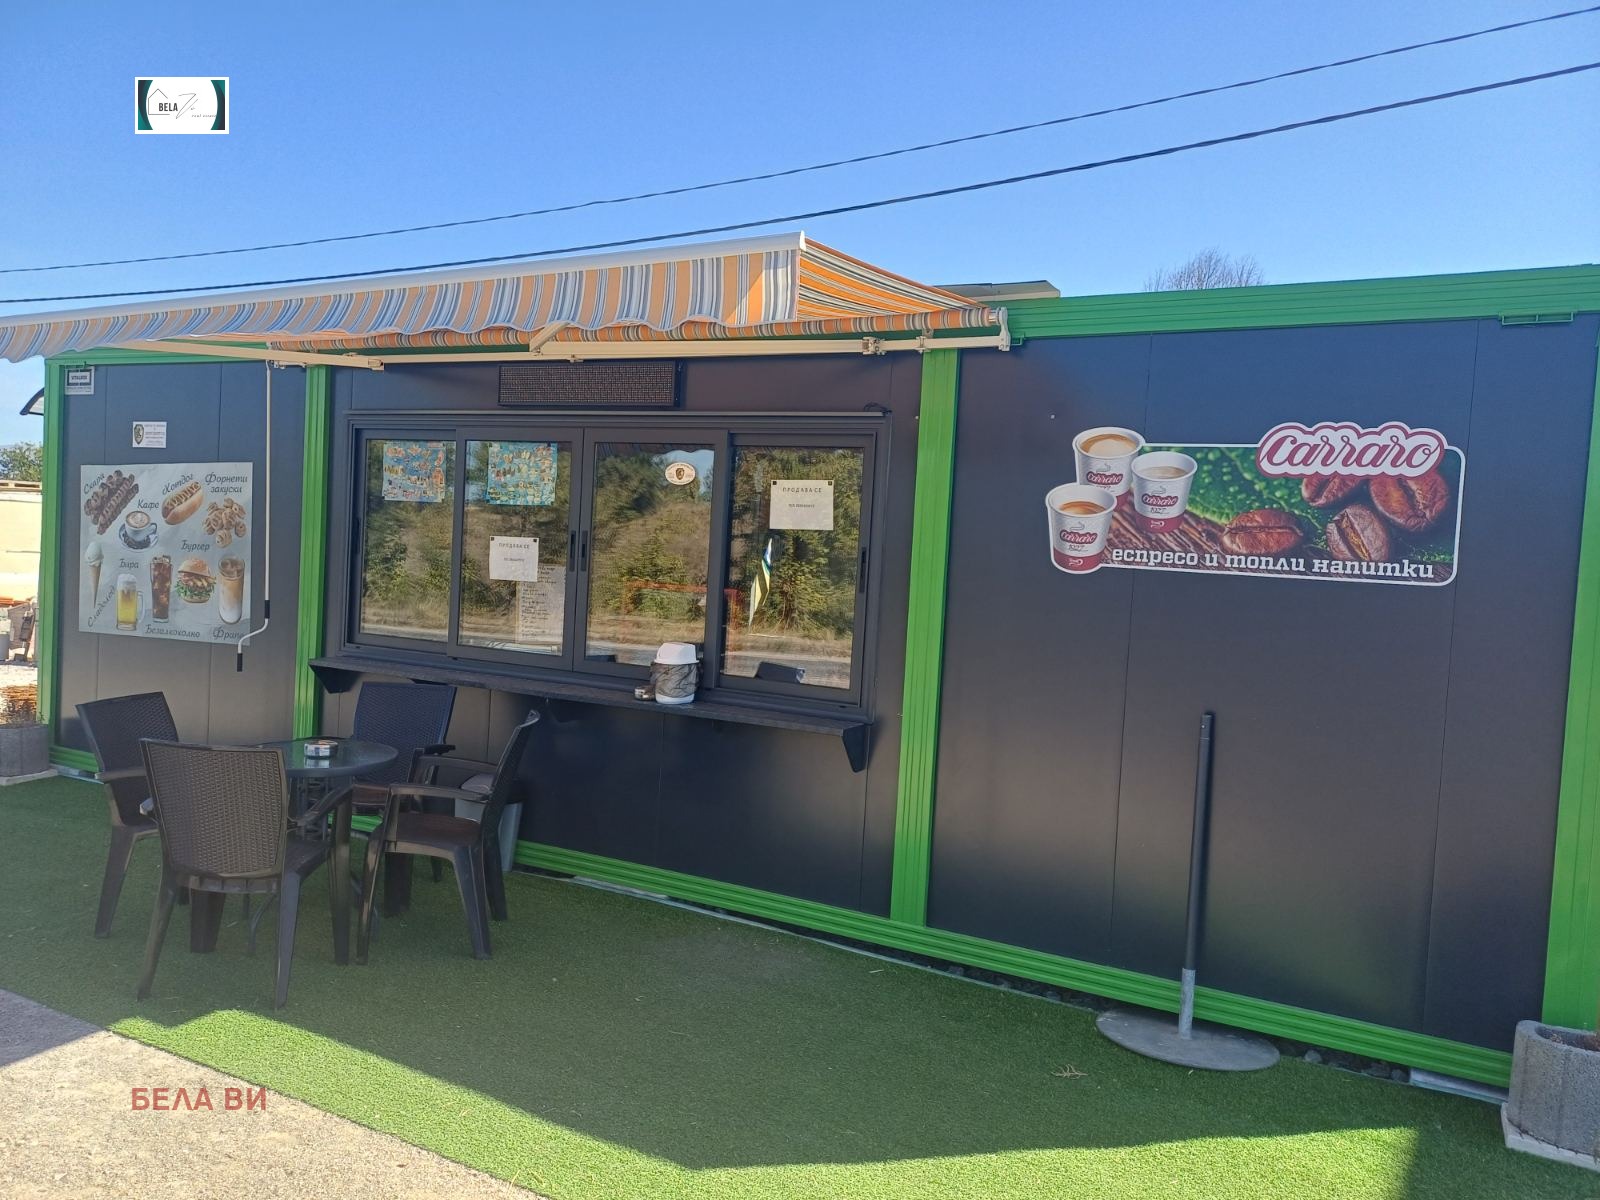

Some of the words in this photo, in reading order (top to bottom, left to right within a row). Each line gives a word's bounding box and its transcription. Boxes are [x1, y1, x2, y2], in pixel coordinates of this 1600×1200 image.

[1260, 435, 1440, 469] Carraro
[84, 473, 105, 494] Скара
[162, 473, 193, 495] Хотдог
[205, 472, 248, 485] Форнети
[210, 486, 242, 495] закуски
[137, 499, 160, 510] Кафе
[181, 540, 210, 552] Бургер
[119, 558, 139, 569] Бира
[1112, 549, 1199, 566] еспресо
[1205, 553, 1218, 567] и
[1224, 554, 1305, 572] топли
[1312, 559, 1434, 578] напитки
